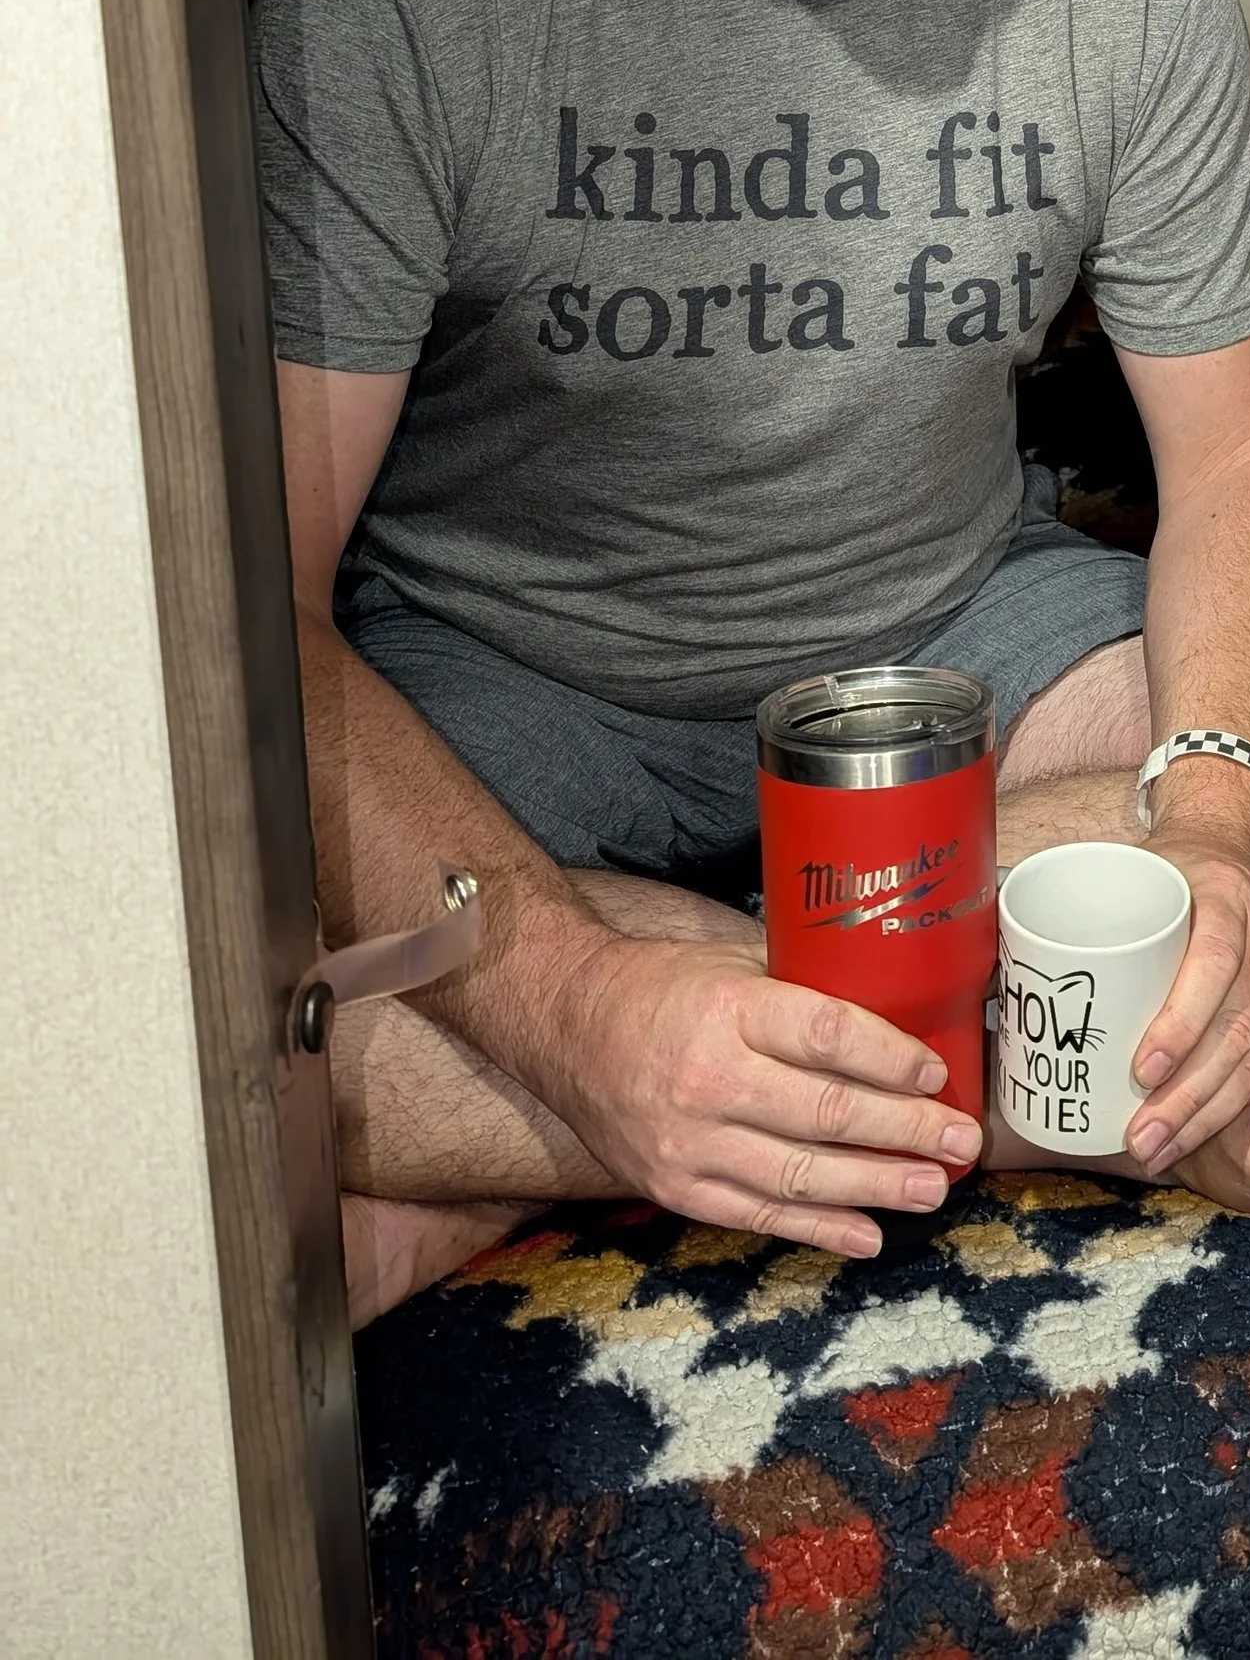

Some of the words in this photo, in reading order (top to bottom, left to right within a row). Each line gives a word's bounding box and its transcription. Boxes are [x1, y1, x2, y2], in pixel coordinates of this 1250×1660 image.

[546, 106, 890, 222] kinda
[926, 111, 1057, 218] fit
[537, 263, 854, 361] sorta
[893, 244, 1044, 348] fat
[796, 839, 960, 912] Milwaukee
[1023, 1045, 1090, 1093] YOUR
